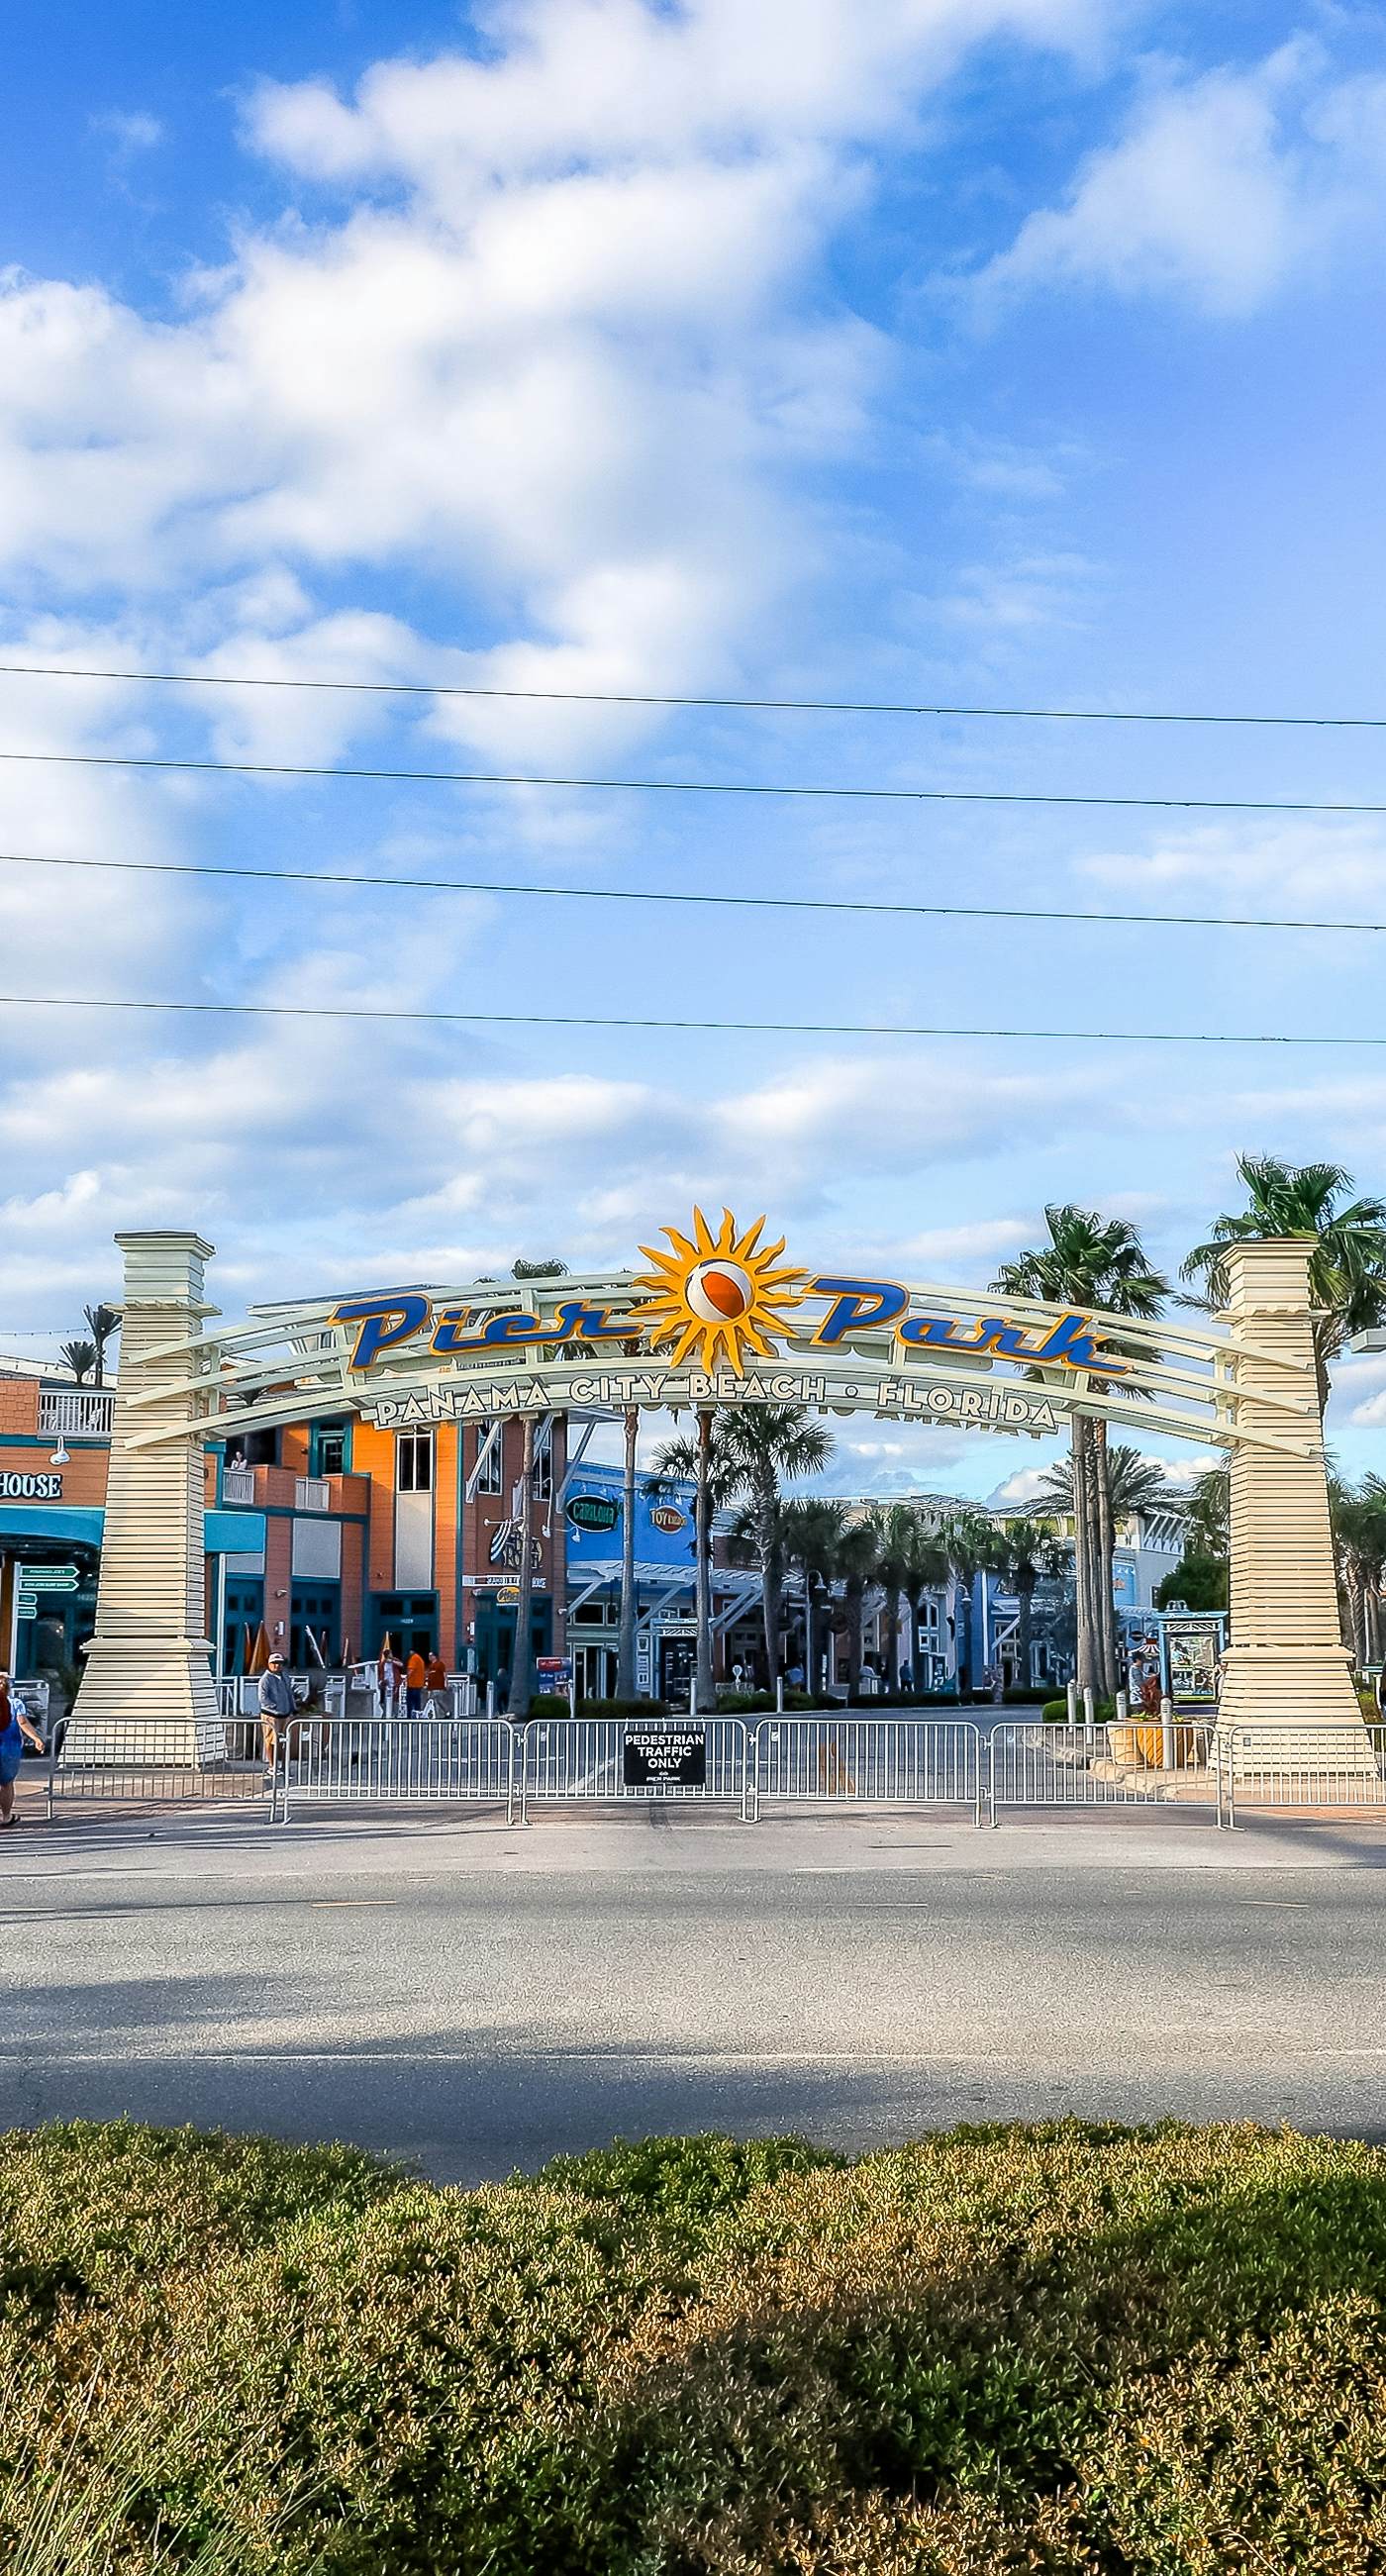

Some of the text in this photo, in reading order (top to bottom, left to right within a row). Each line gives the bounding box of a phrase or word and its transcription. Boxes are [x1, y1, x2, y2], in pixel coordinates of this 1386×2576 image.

[328, 1275, 1135, 1375] Pier Park
[376, 1371, 1057, 1431] PANAMA CITY BEACH FLORIDA
[625, 1734, 704, 1745] PEDESTRIAN
[637, 1746, 692, 1757] TRAFFIC
[647, 1758, 682, 1769] ONLY
